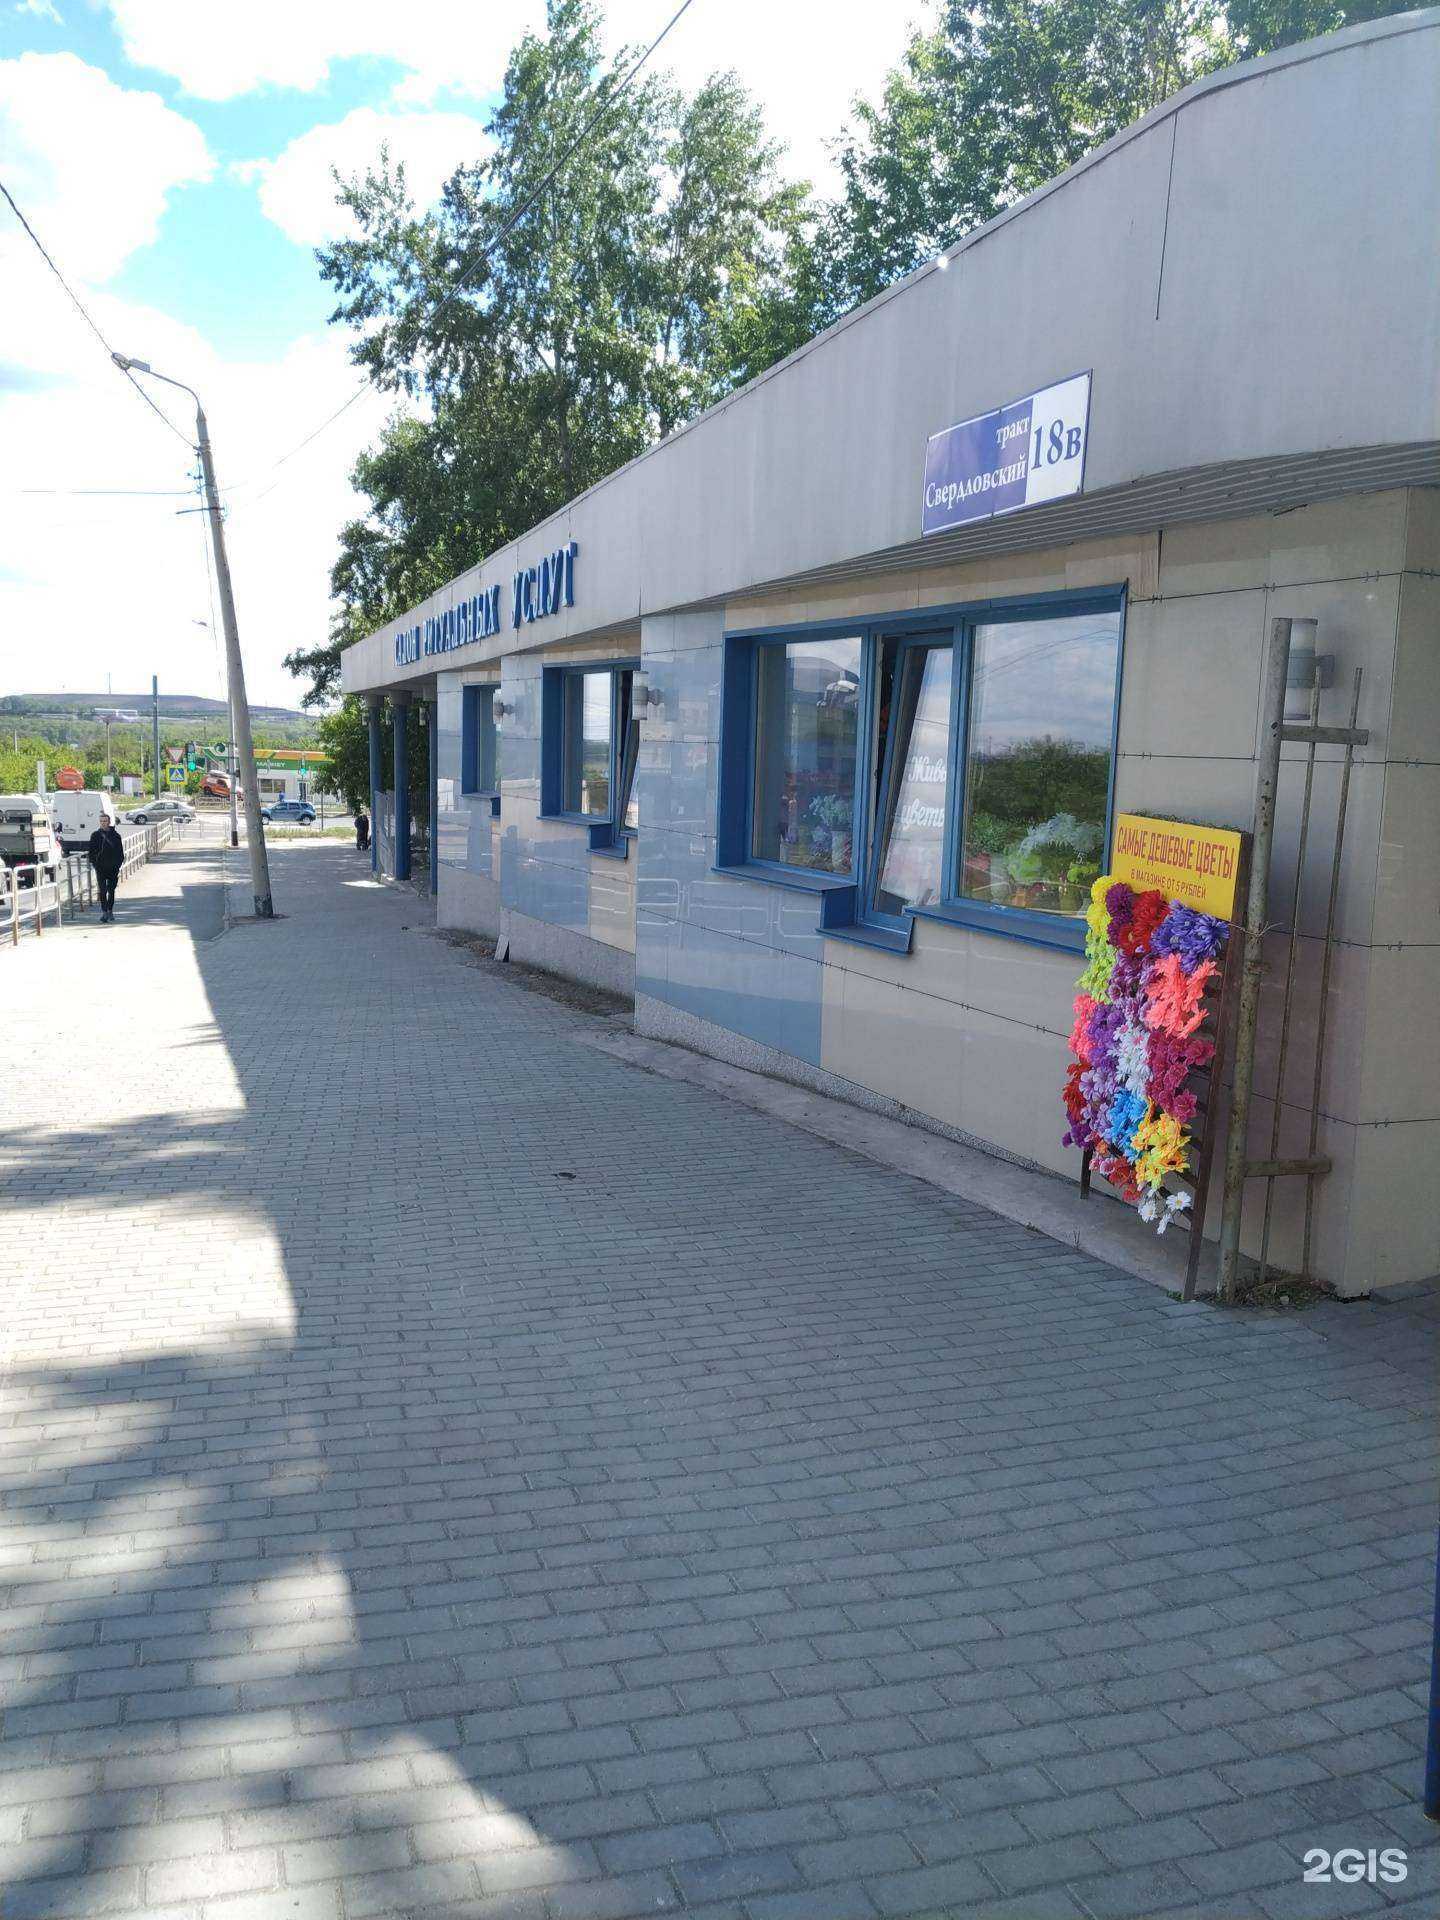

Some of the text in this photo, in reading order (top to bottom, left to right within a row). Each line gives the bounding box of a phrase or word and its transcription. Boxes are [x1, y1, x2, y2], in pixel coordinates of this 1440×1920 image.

[996, 417, 1030, 450] тракт
[926, 453, 1027, 510] Свердловский
[511, 541, 578, 630] УСЛУГ
[1117, 826, 1235, 880] САМЫЕ ДЕШЕВЫЕ ЦВЕТЫ
[1167, 877, 1175, 890] ОТ
